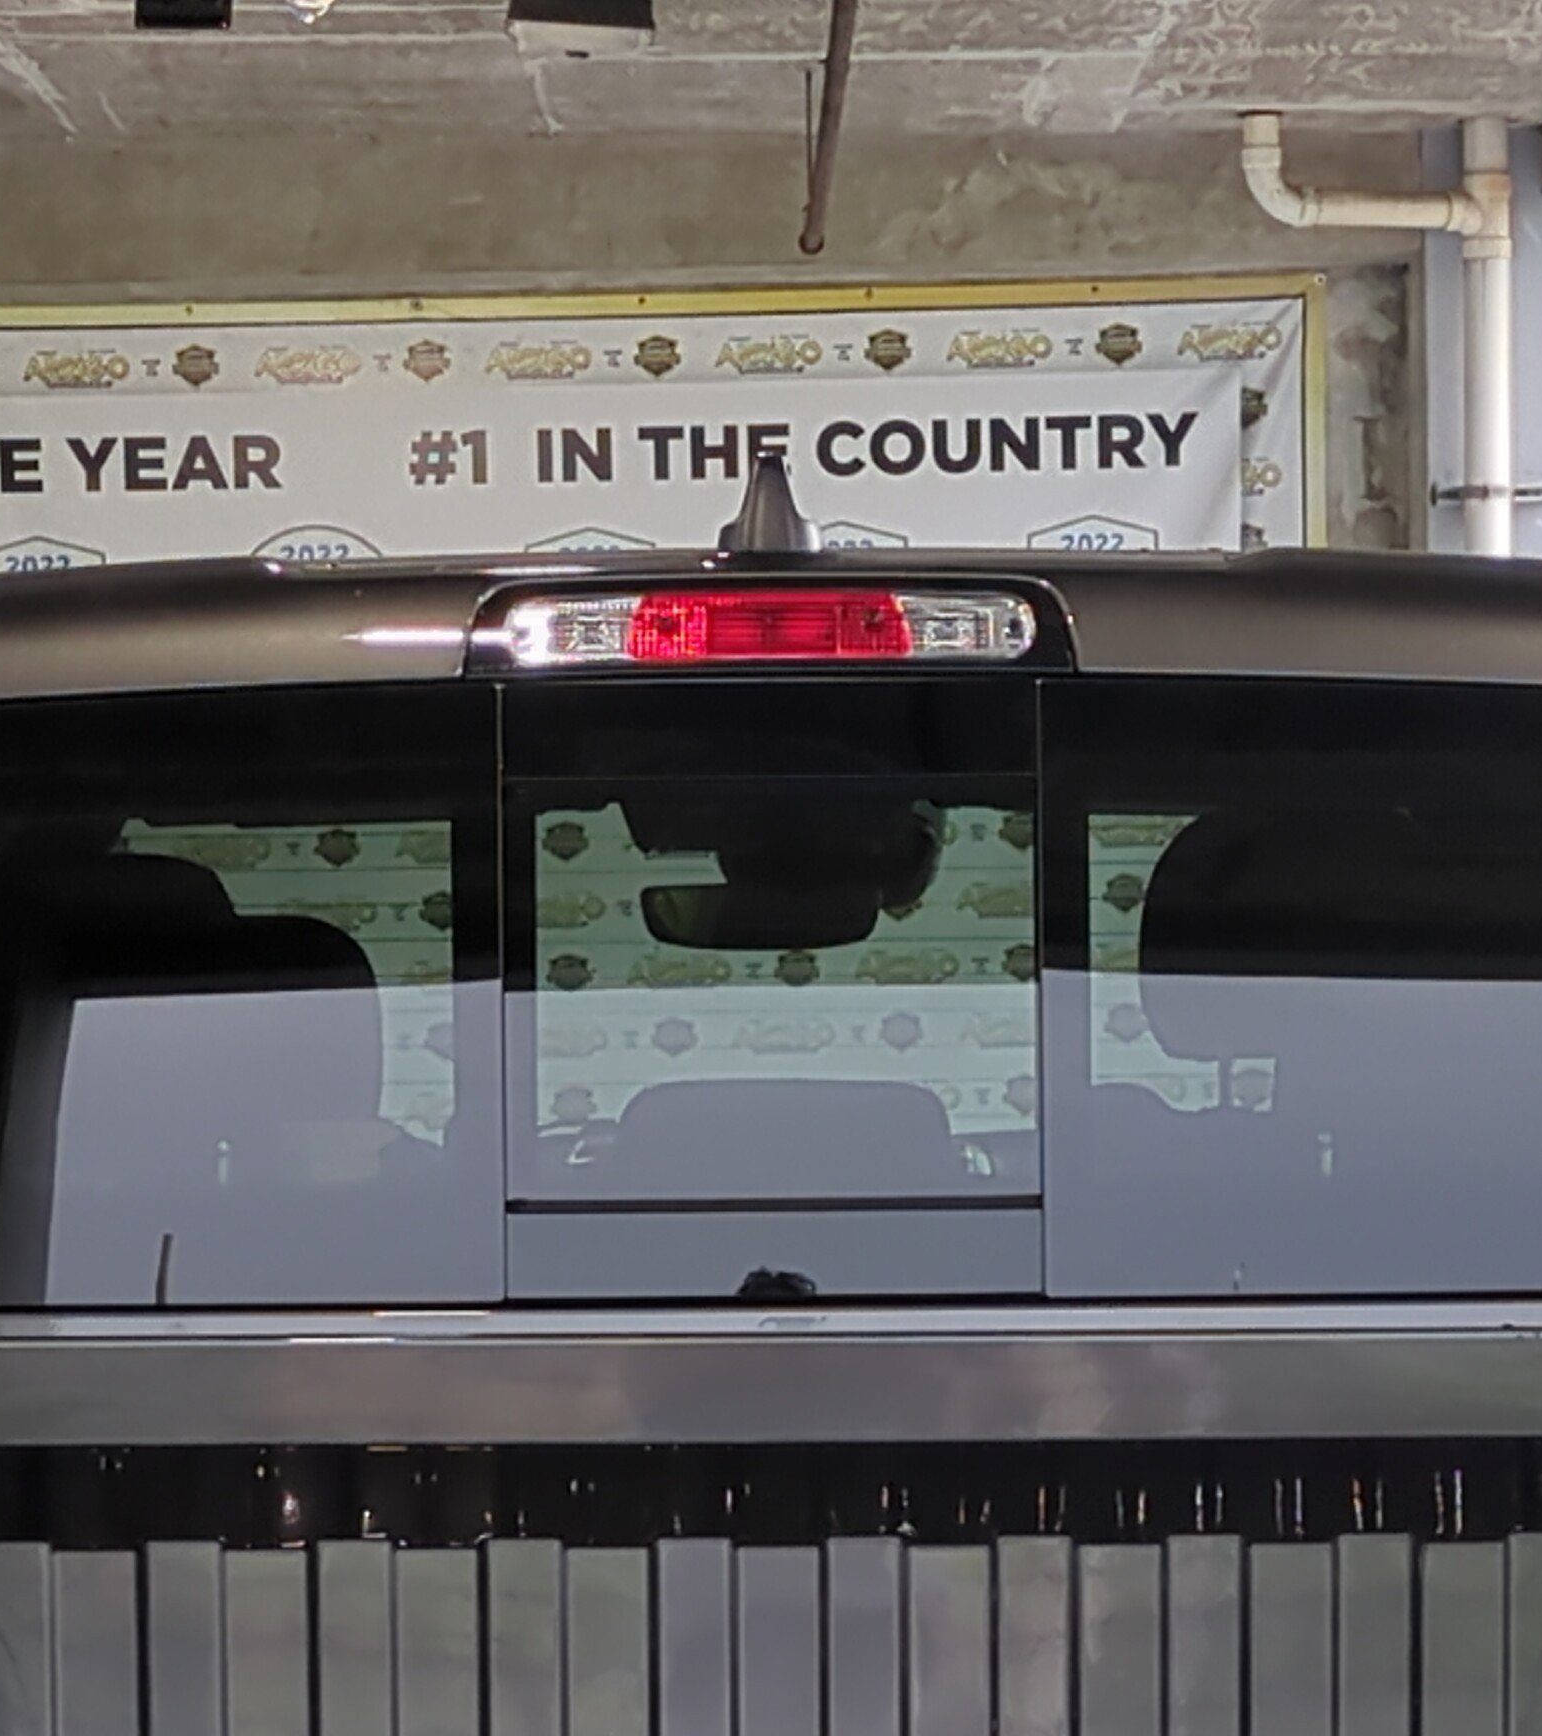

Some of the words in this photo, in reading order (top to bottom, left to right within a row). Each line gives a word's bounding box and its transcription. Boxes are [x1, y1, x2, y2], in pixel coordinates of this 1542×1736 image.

[66, 434, 282, 492] YEAR
[408, 429, 488, 486] #1
[537, 427, 613, 483] IN
[638, 423, 790, 480] THE
[815, 411, 1199, 477] COUNTRY
